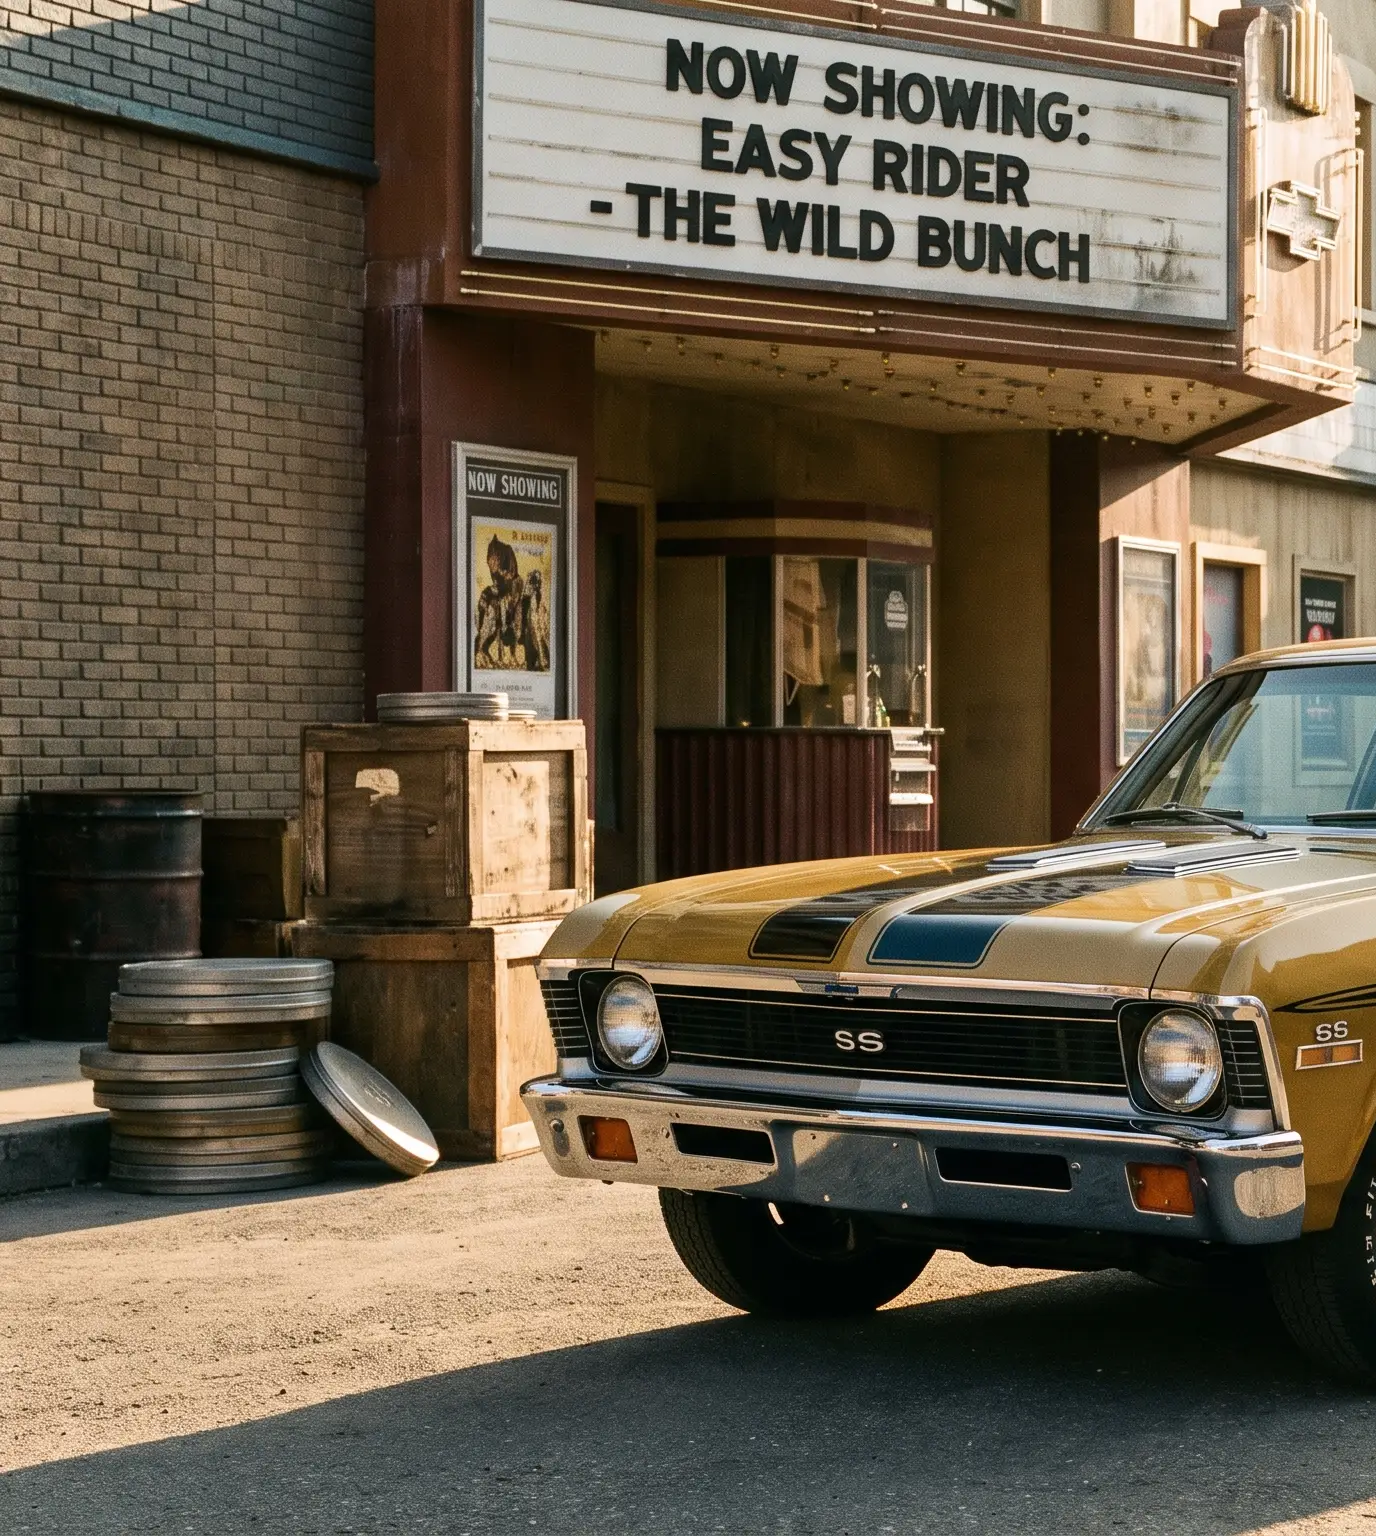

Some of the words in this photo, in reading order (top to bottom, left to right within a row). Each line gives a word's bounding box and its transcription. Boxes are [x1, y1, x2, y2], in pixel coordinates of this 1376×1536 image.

[666, 38, 798, 106] NOW
[824, 61, 1090, 146] SHOWING:
[701, 117, 852, 186] EASY
[873, 138, 1030, 207] RIDER
[756, 197, 895, 262] WILD
[918, 215, 1090, 283] BUNCH
[468, 470, 496, 493] NOW
[501, 474, 557, 500] SHOWING
[835, 1030, 884, 1052] SS
[1315, 1020, 1348, 1041] SS
